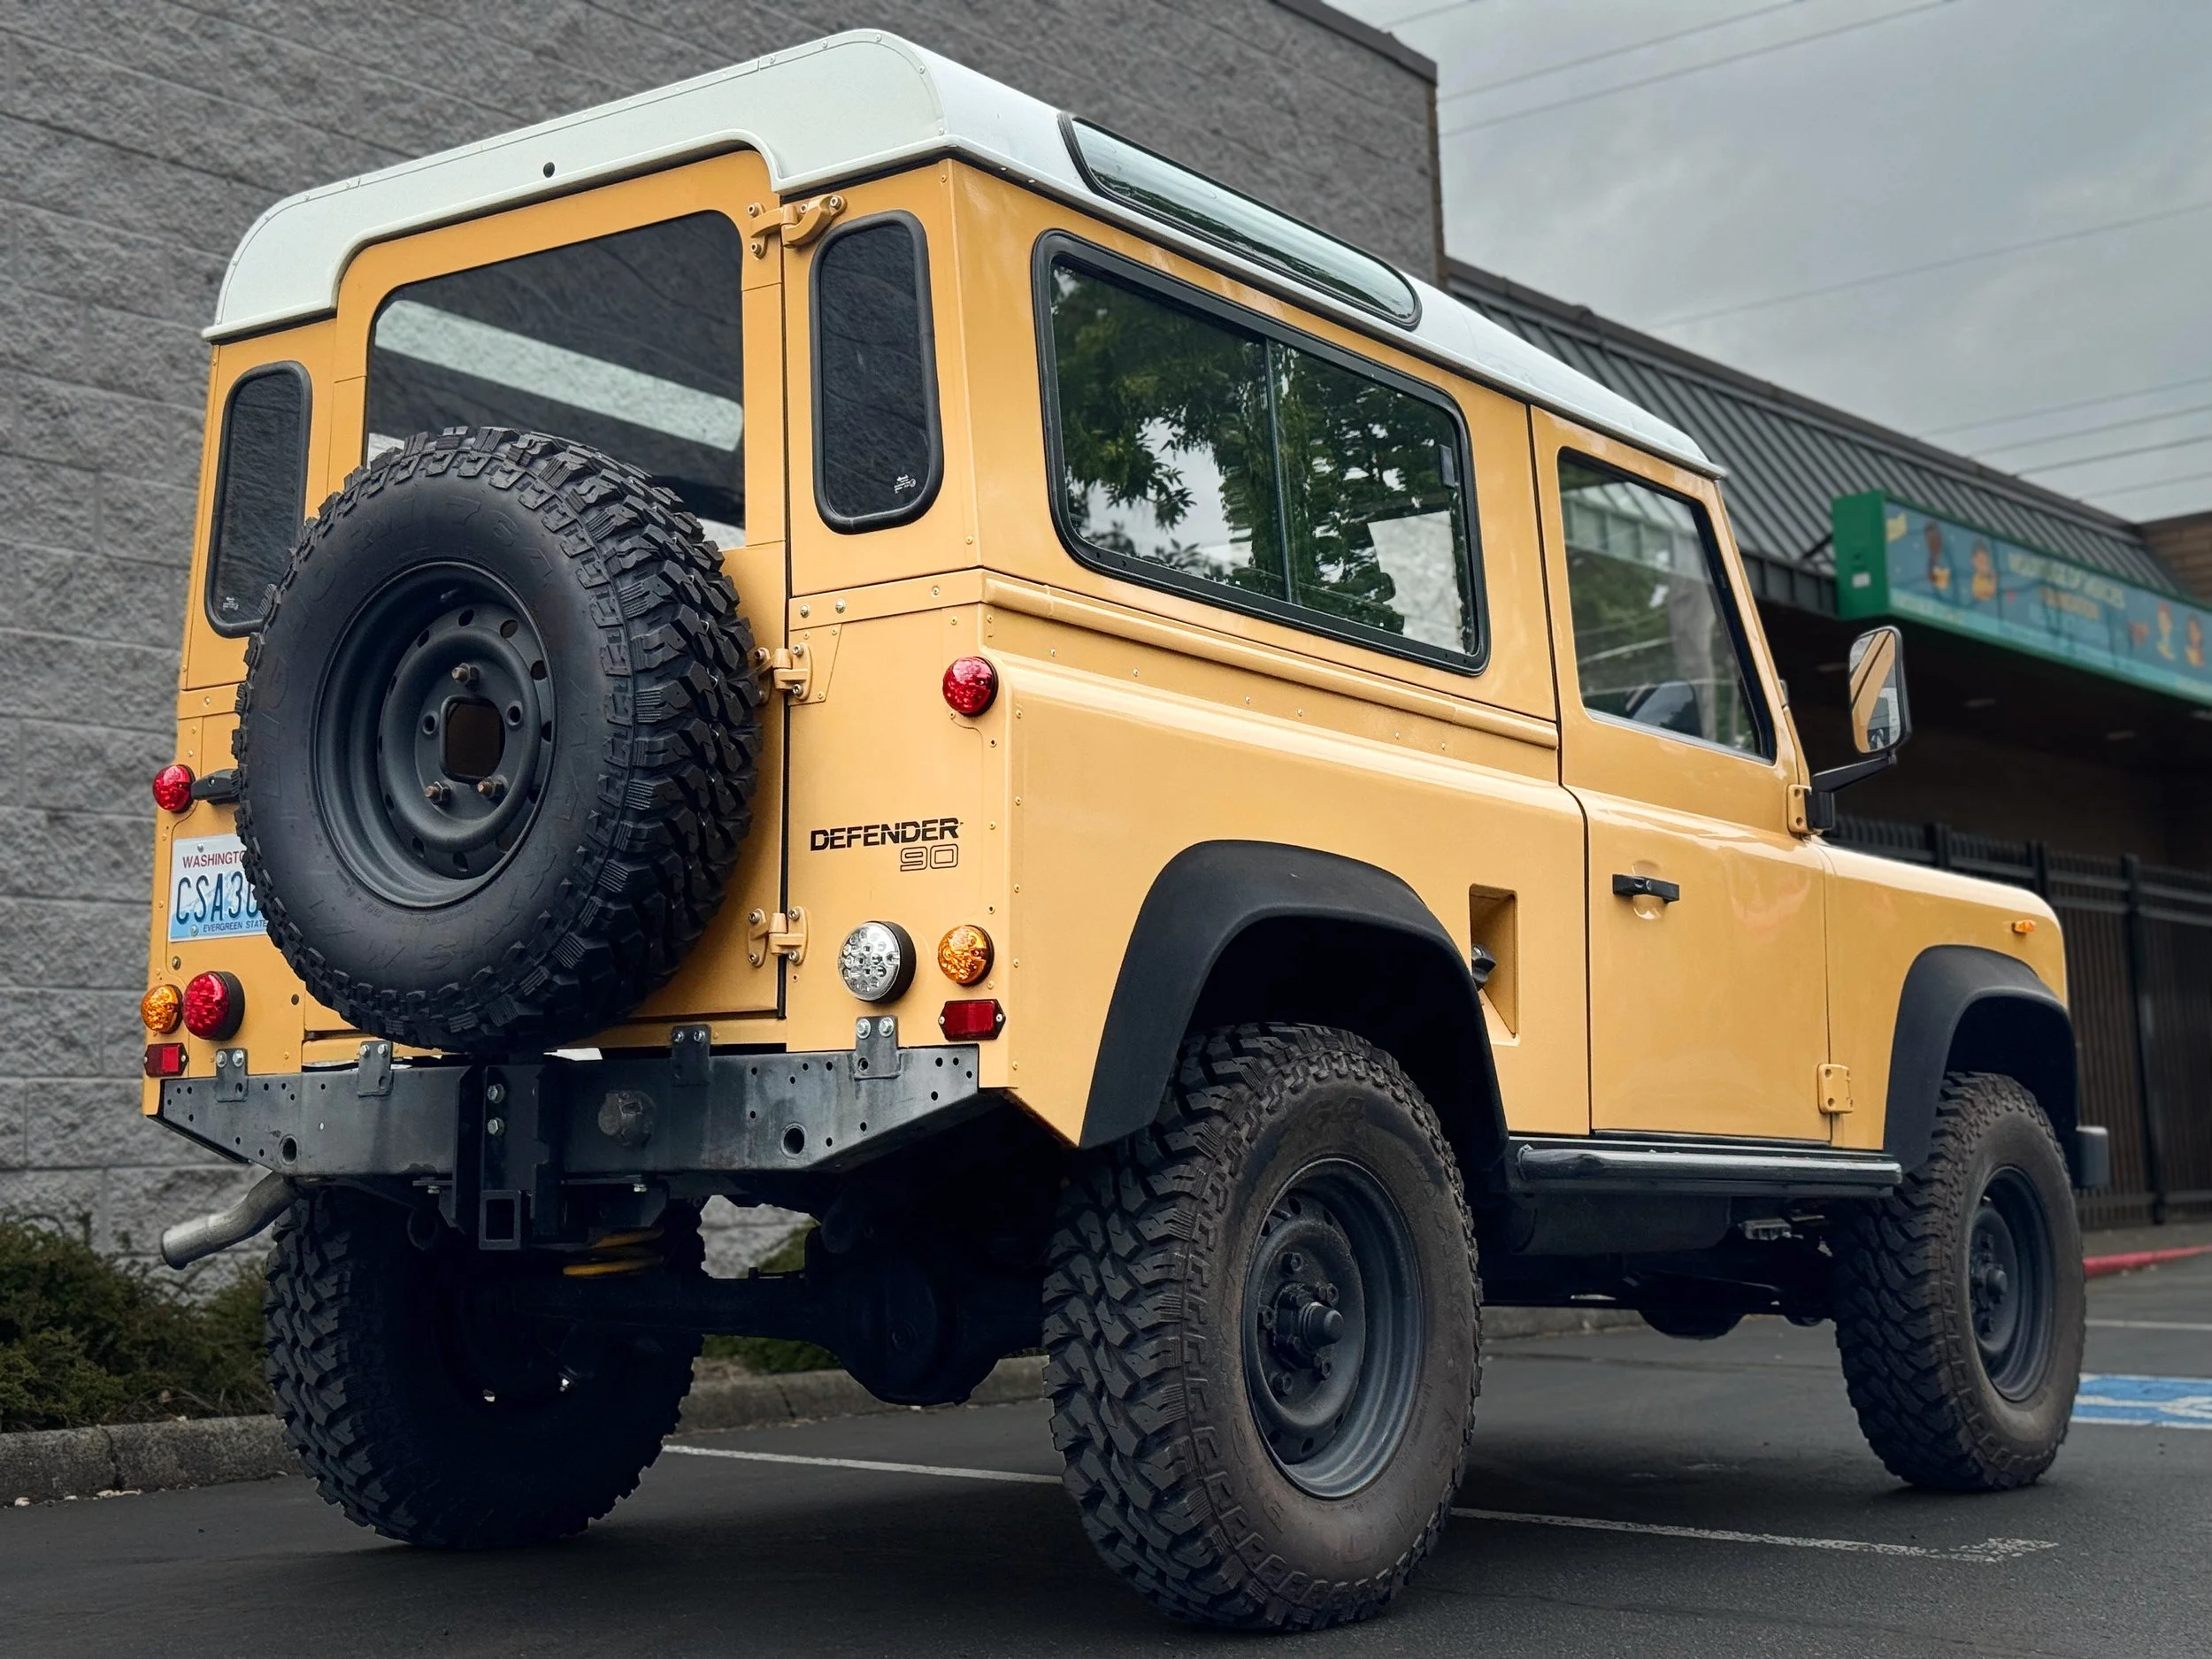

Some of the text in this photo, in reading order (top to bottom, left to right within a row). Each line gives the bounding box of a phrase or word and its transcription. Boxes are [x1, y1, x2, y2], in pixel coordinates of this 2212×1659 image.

[810, 818, 959, 851] DEFENDER
[900, 843, 958, 872] 90
[203, 920, 266, 933] EVERGREEN STATE
